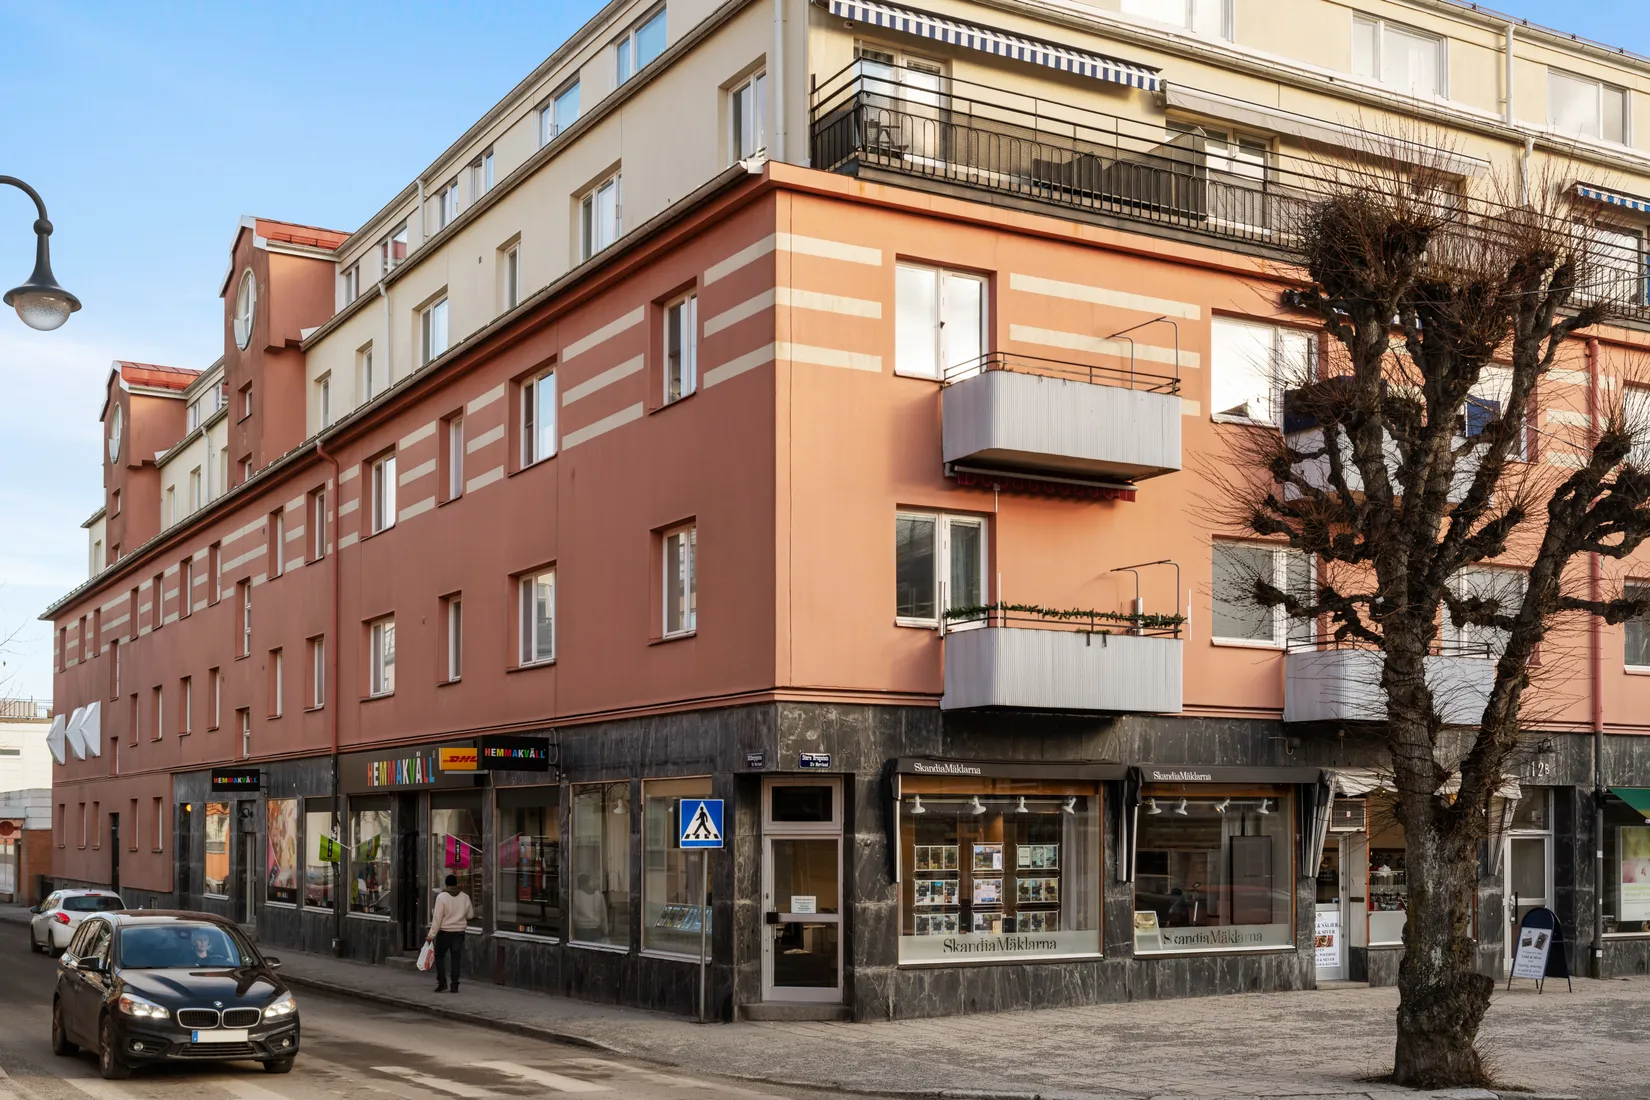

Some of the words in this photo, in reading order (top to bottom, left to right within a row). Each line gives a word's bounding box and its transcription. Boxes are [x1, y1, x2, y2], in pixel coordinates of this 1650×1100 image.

[485, 748, 545, 759] HEMMAKVÄLL
[367, 751, 435, 787] HEMMAKVÄLL
[914, 762, 981, 775] SkandiaMäklarna
[213, 776, 258, 784] HEMMAKVÄLL
[1153, 771, 1212, 781] SkandiaMäklarna
[1163, 929, 1263, 945] SkandiaMäklarna
[943, 937, 1057, 953] SkandiaMäklarna
